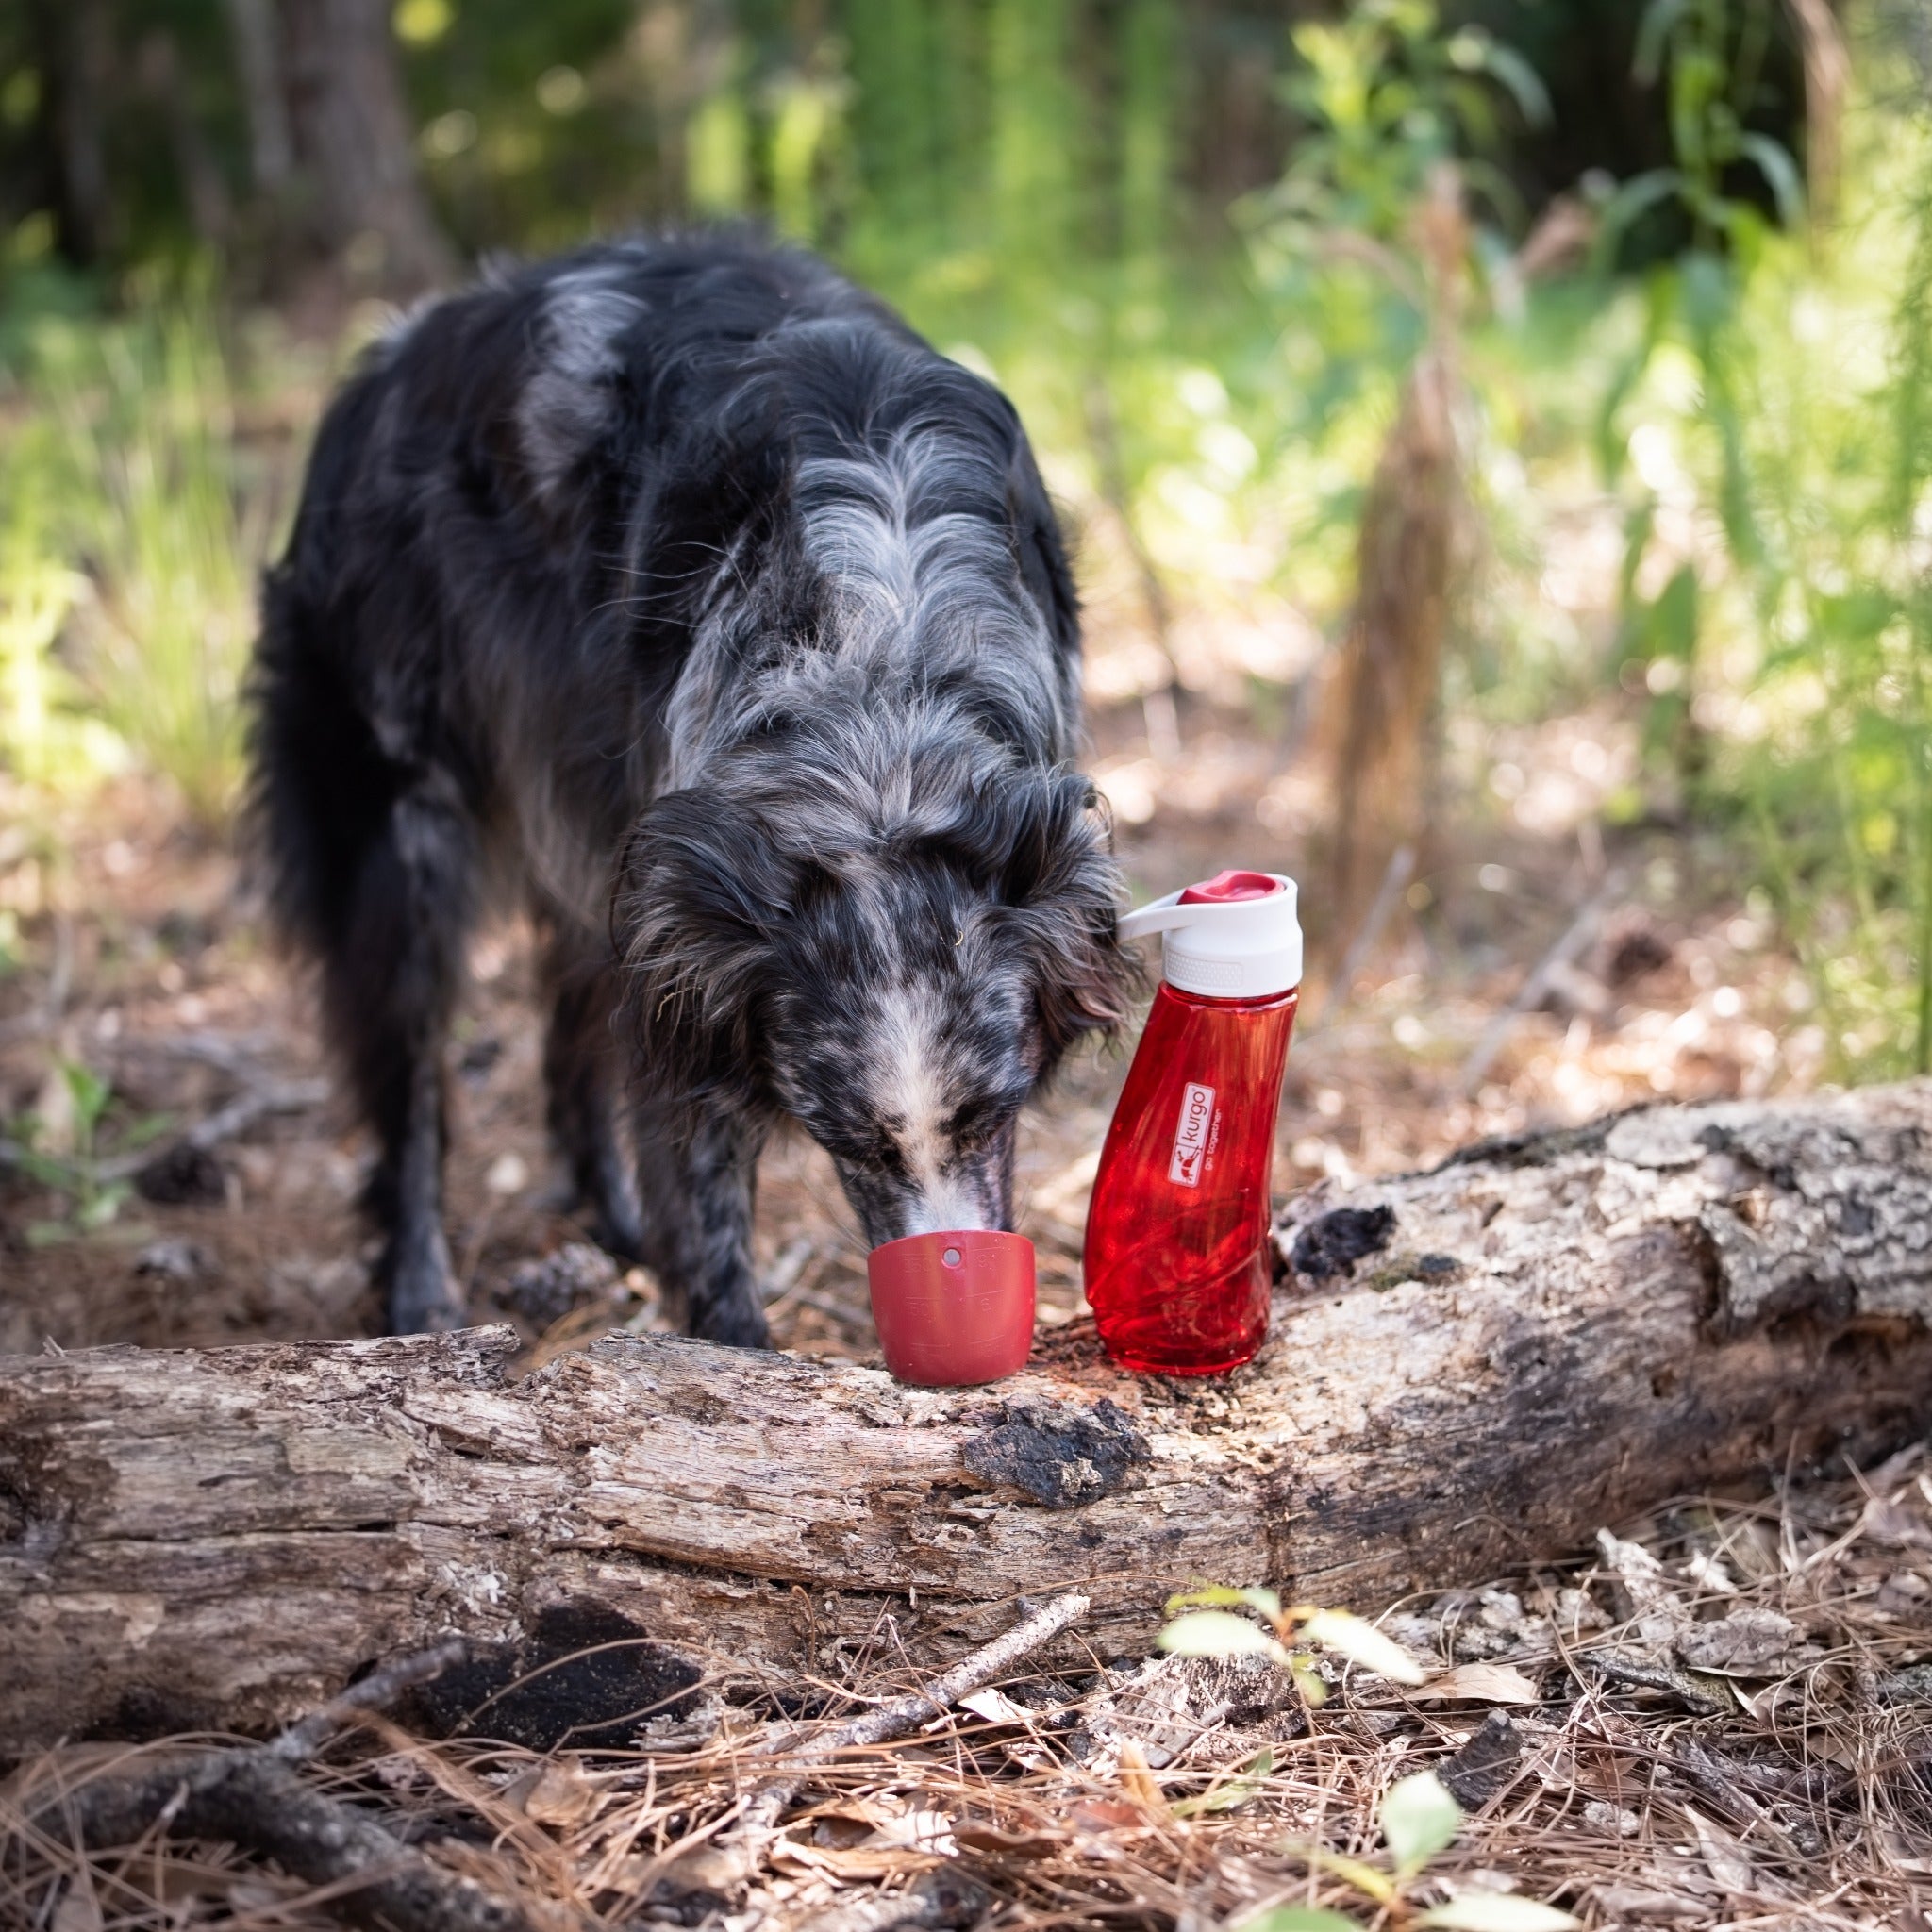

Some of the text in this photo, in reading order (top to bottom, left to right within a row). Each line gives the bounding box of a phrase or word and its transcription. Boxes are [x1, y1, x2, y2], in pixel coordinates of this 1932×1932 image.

[1181, 1091, 1208, 1142] kurgo
[1204, 1108, 1222, 1171] go together
